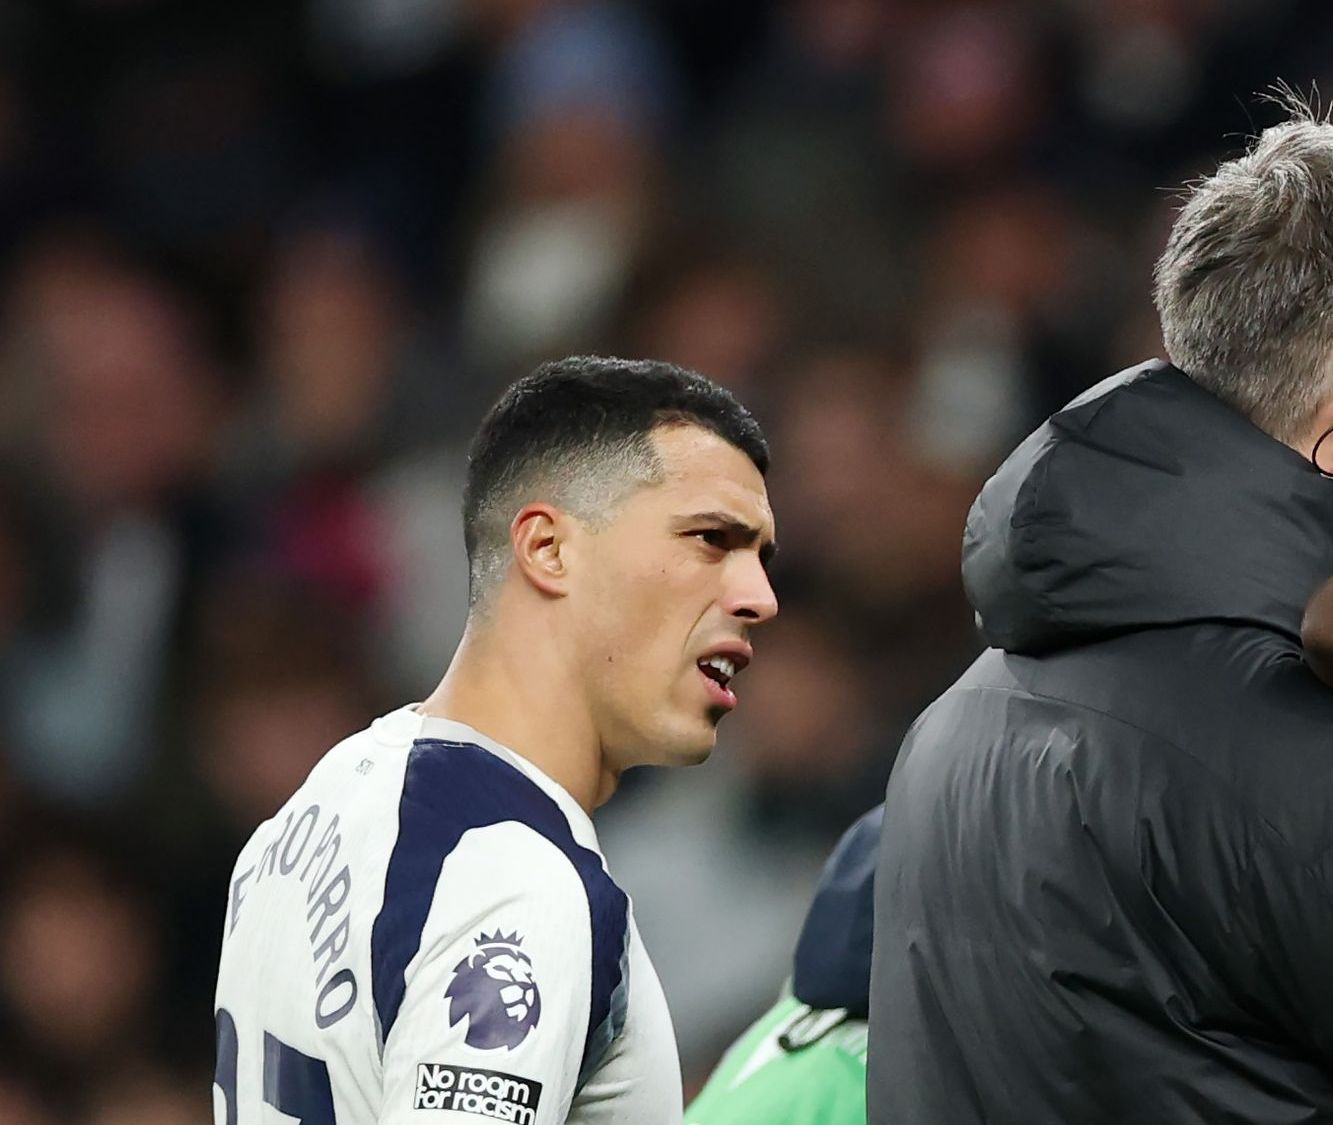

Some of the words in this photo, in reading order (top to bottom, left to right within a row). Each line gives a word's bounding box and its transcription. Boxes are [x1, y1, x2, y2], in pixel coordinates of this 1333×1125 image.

[414, 1085, 452, 1109] for
[418, 1064, 455, 1089] No
[457, 1071, 530, 1104] room
